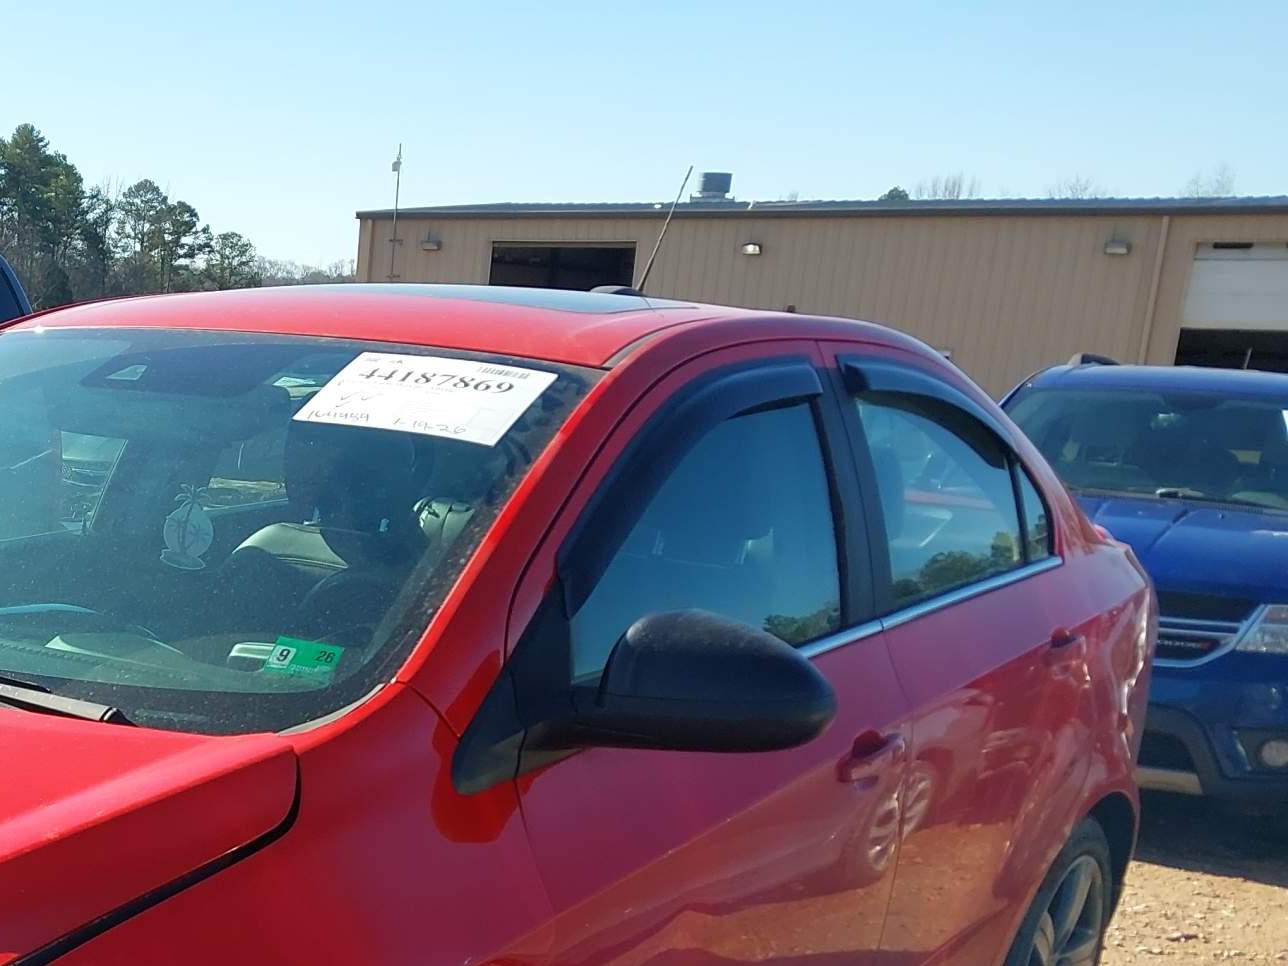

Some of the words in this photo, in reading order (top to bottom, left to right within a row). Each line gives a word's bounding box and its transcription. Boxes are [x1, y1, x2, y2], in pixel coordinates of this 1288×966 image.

[358, 367, 515, 394] 44187869
[276, 648, 291, 662] 9
[315, 650, 336, 664] 26
